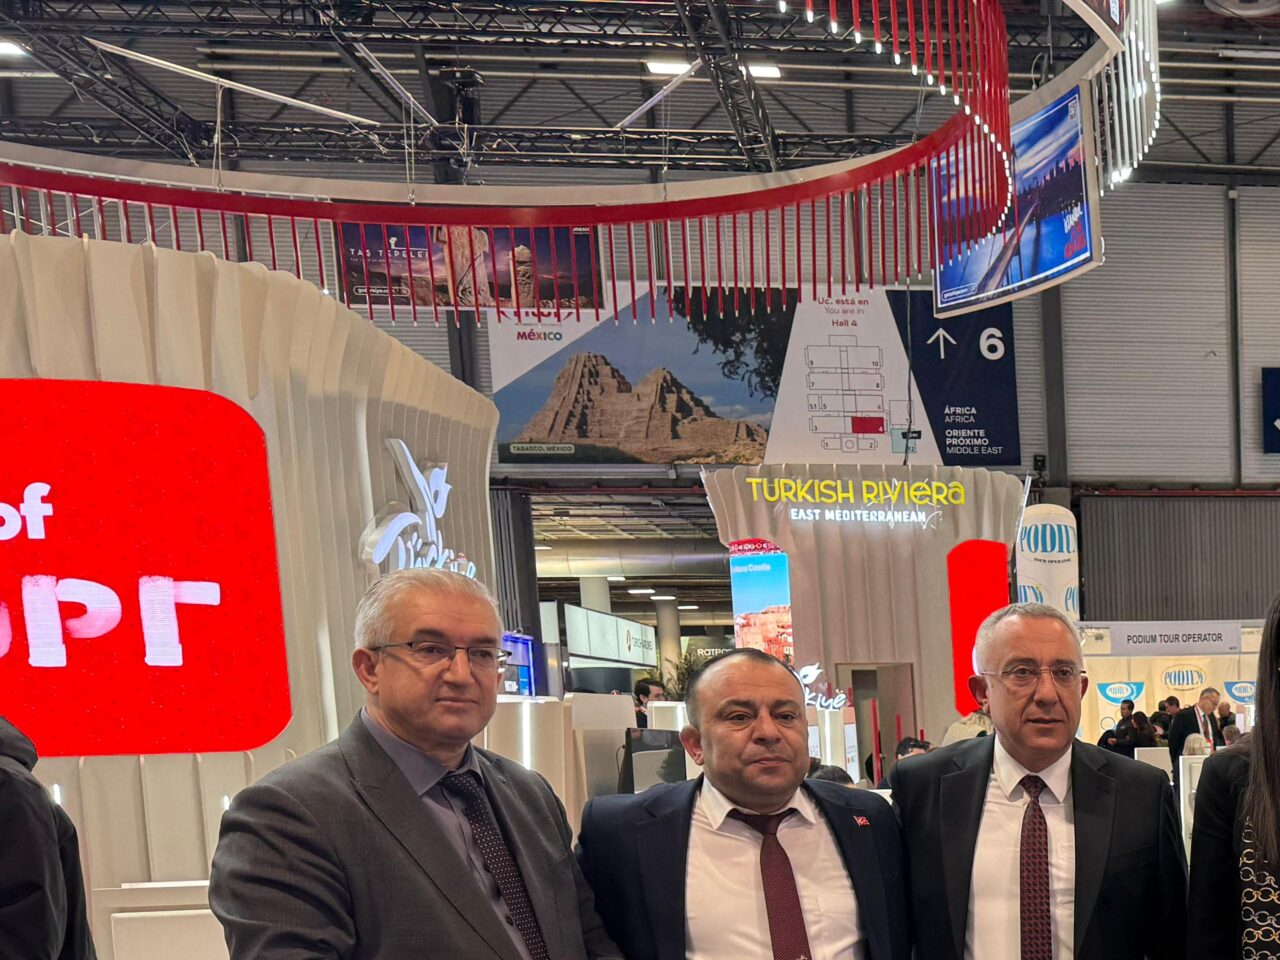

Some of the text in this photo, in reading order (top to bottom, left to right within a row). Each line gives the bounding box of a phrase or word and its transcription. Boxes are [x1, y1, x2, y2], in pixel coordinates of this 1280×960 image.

[979, 326, 1005, 361] 6
[944, 404, 977, 415] ÁFRICA
[944, 415, 975, 423] AFRICA
[945, 429, 986, 437] ORIENTE
[945, 436, 989, 446] PRÓXIMO
[946, 446, 1003, 454] MIDDLE EAST
[745, 478, 854, 504] TURKISH
[790, 508, 926, 523] EAST MEDITERRANEAN
[1127, 632, 1223, 644] PODIUM TOUR OPERATOR
